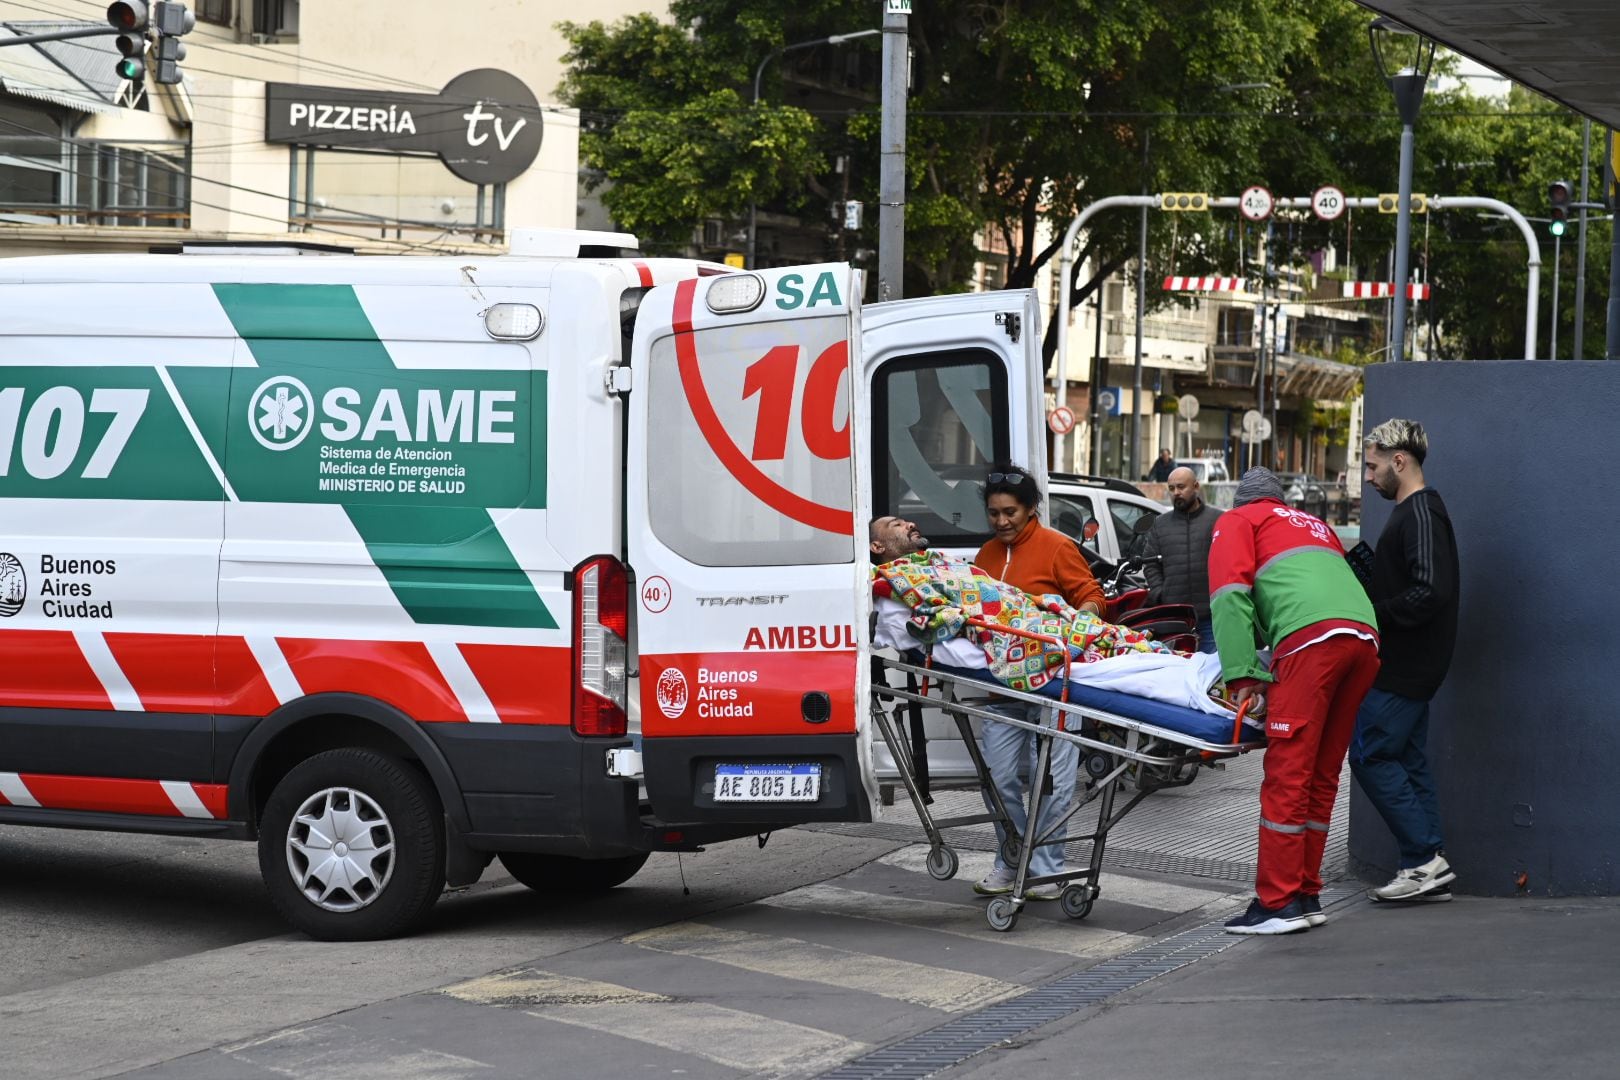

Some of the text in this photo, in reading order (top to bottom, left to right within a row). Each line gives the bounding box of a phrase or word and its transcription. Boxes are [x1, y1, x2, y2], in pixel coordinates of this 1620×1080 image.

[290, 101, 527, 150] PIZZERÍA tv
[1319, 197, 1338, 209] 40
[775, 271, 842, 310] SA
[320, 387, 516, 443] SAME
[0, 385, 150, 479] 107
[320, 446, 452, 461] Sistema de Atencion
[320, 462, 465, 479] Medica de Emergencia
[319, 478, 465, 494] MINISTERIO DE SALUD
[41, 554, 116, 574] Buenos
[41, 579, 92, 597] Aires
[696, 595, 789, 606] TRANSIT
[42, 600, 113, 619] Ciudad
[743, 625, 857, 650] AMBUL
[698, 668, 758, 684] Buenos
[697, 686, 738, 700] Aires
[698, 702, 753, 718] Ciudad
[1270, 722, 1290, 731] SAME
[720, 776, 813, 797] AE 805 LA
